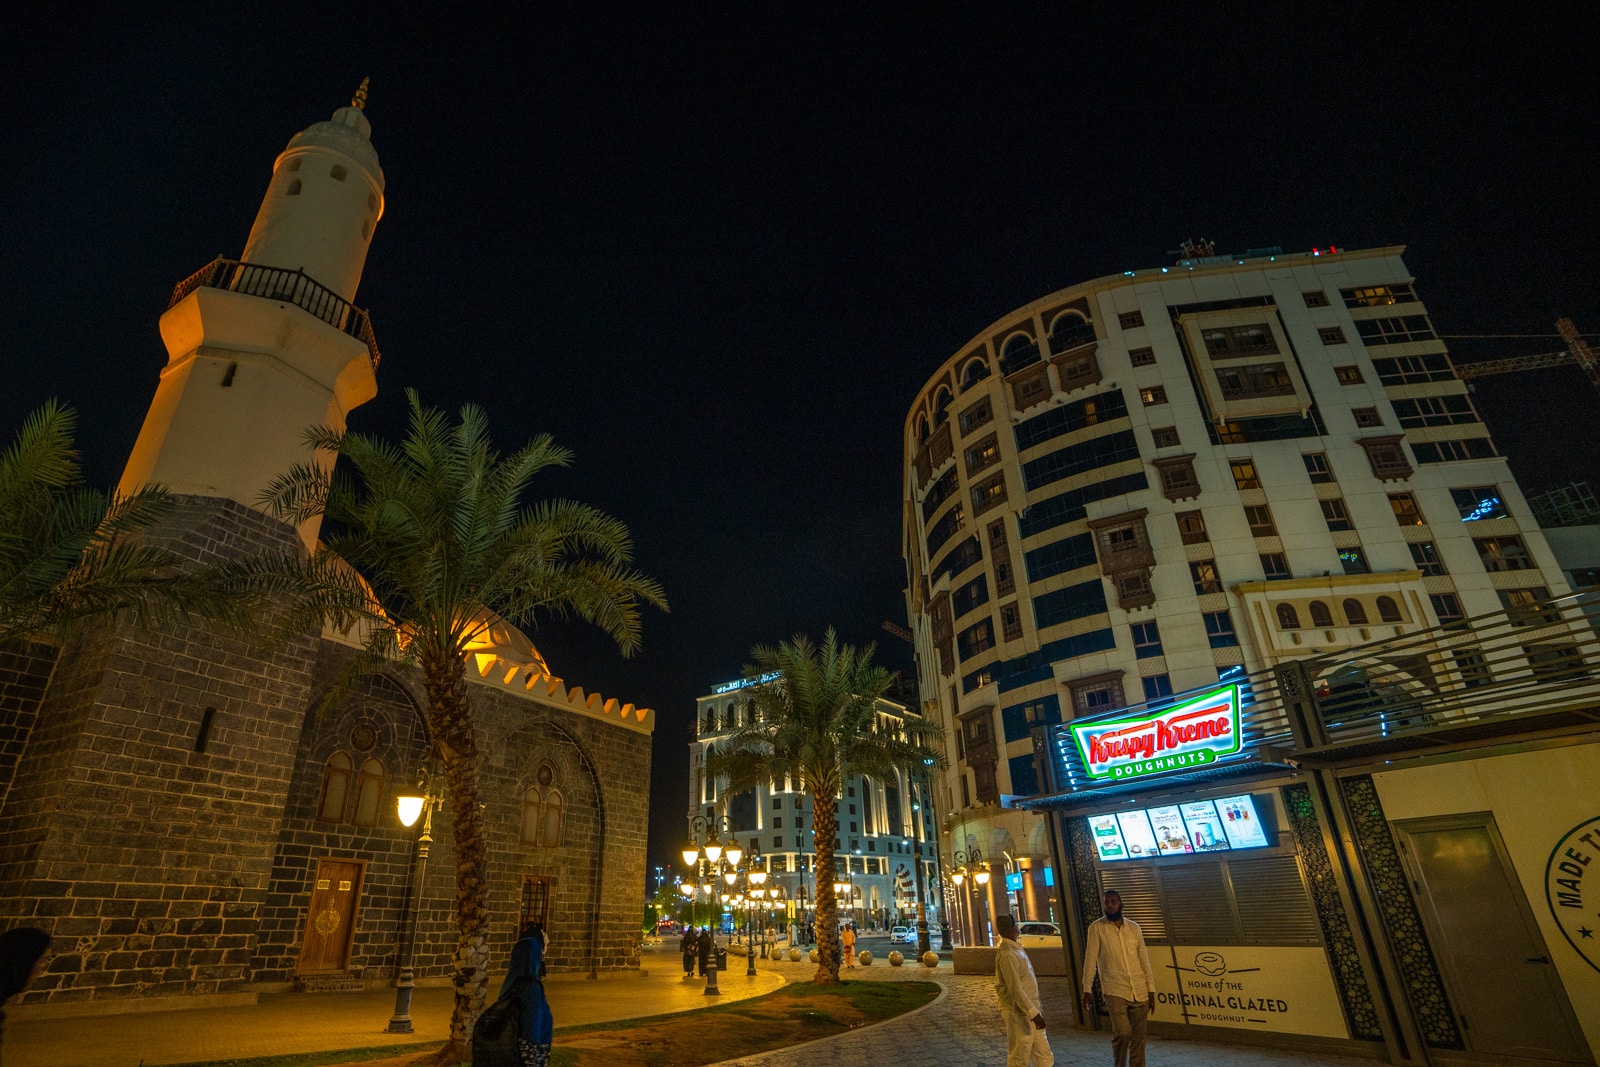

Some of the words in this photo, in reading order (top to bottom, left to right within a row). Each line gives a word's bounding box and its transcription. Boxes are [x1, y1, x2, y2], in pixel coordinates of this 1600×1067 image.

[1088, 720, 1156, 765] Krispy
[1154, 703, 1232, 751] Kreme
[1114, 751, 1206, 777] DOUGHNUTS
[1556, 847, 1592, 909] MADE
[1188, 980, 1213, 989] HOME
[1214, 978, 1225, 992] of
[1225, 982, 1243, 990] THE
[1157, 992, 1226, 1009] ORIGINAL
[1227, 996, 1288, 1013] GLAZED
[1200, 1013, 1245, 1023] DOUGHNUT
